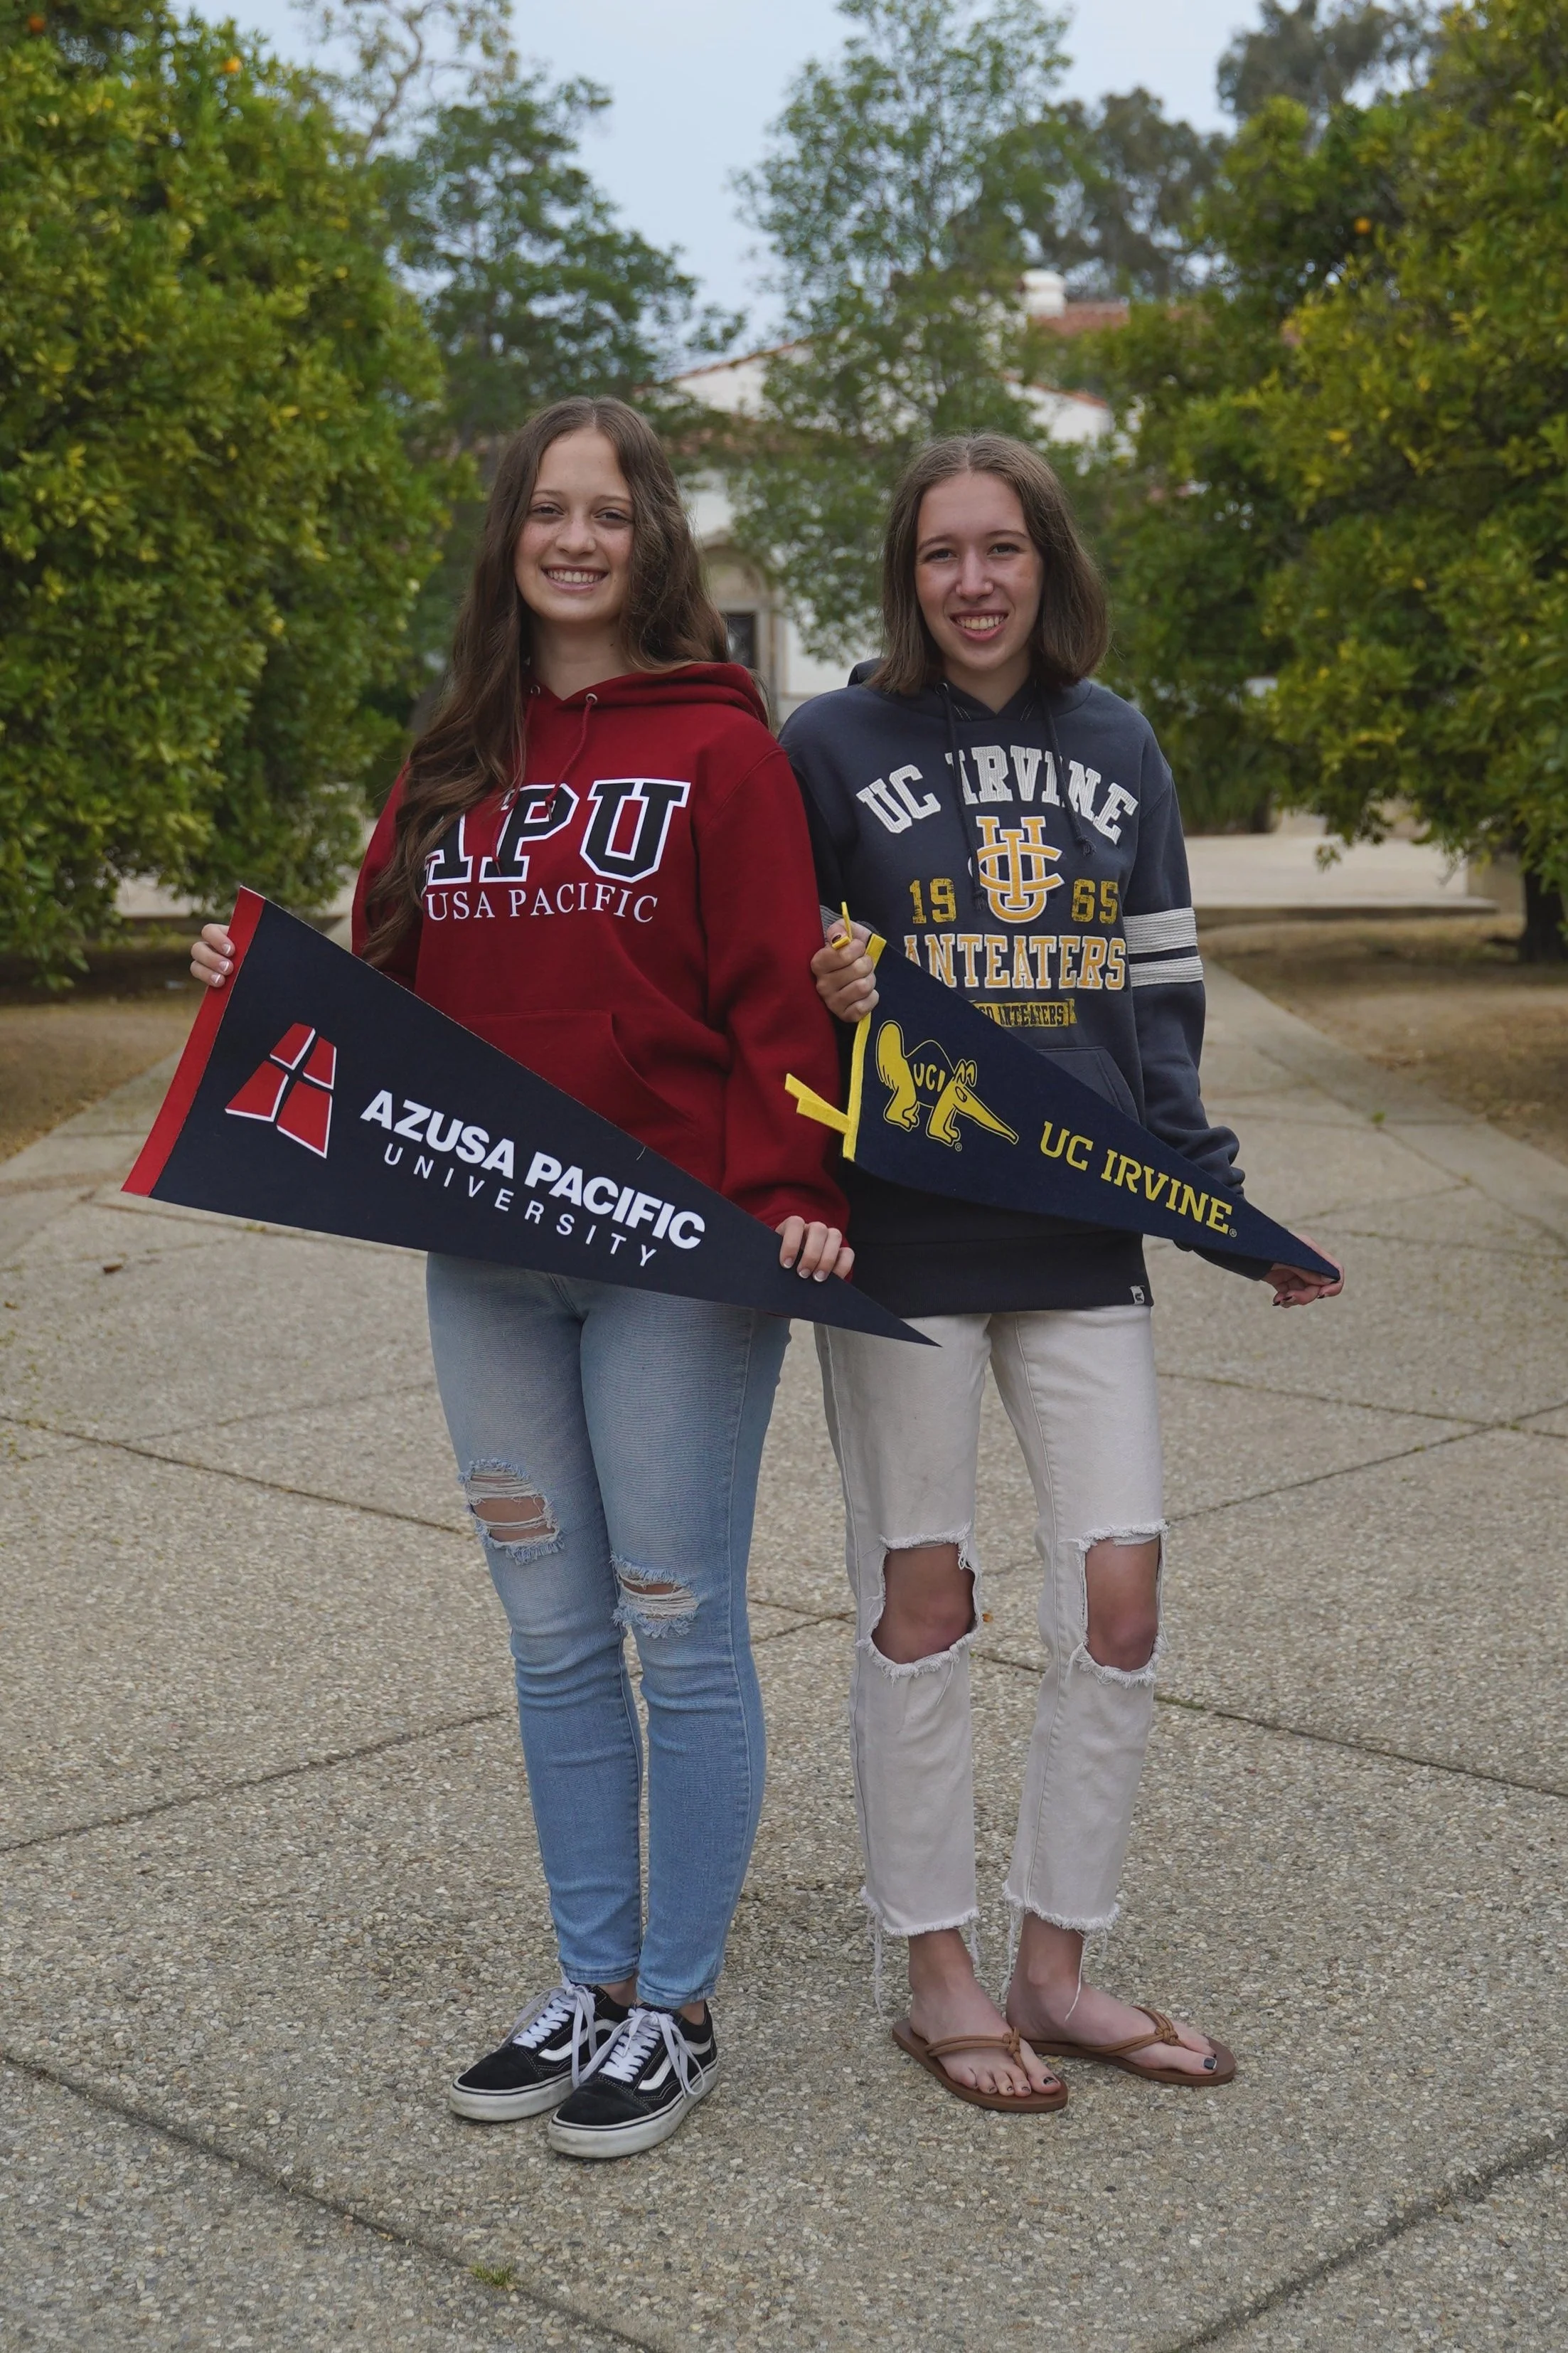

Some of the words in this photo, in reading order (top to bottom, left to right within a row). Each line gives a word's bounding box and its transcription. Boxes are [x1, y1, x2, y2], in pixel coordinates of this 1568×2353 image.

[855, 764, 942, 834] UC
[945, 745, 1138, 845] IRVINE
[425, 891, 496, 921] USA
[508, 882, 658, 923] PACIFIC
[909, 878, 957, 924] 19
[1071, 878, 1119, 925] 65
[913, 1063, 946, 1093] UCI
[360, 1090, 515, 1179] AZUSA
[524, 1152, 705, 1250] PACIFIC
[383, 1143, 657, 1267] UNIVERSITY
[1040, 1120, 1094, 1172] UC
[1101, 1149, 1233, 1235] IRVINE
